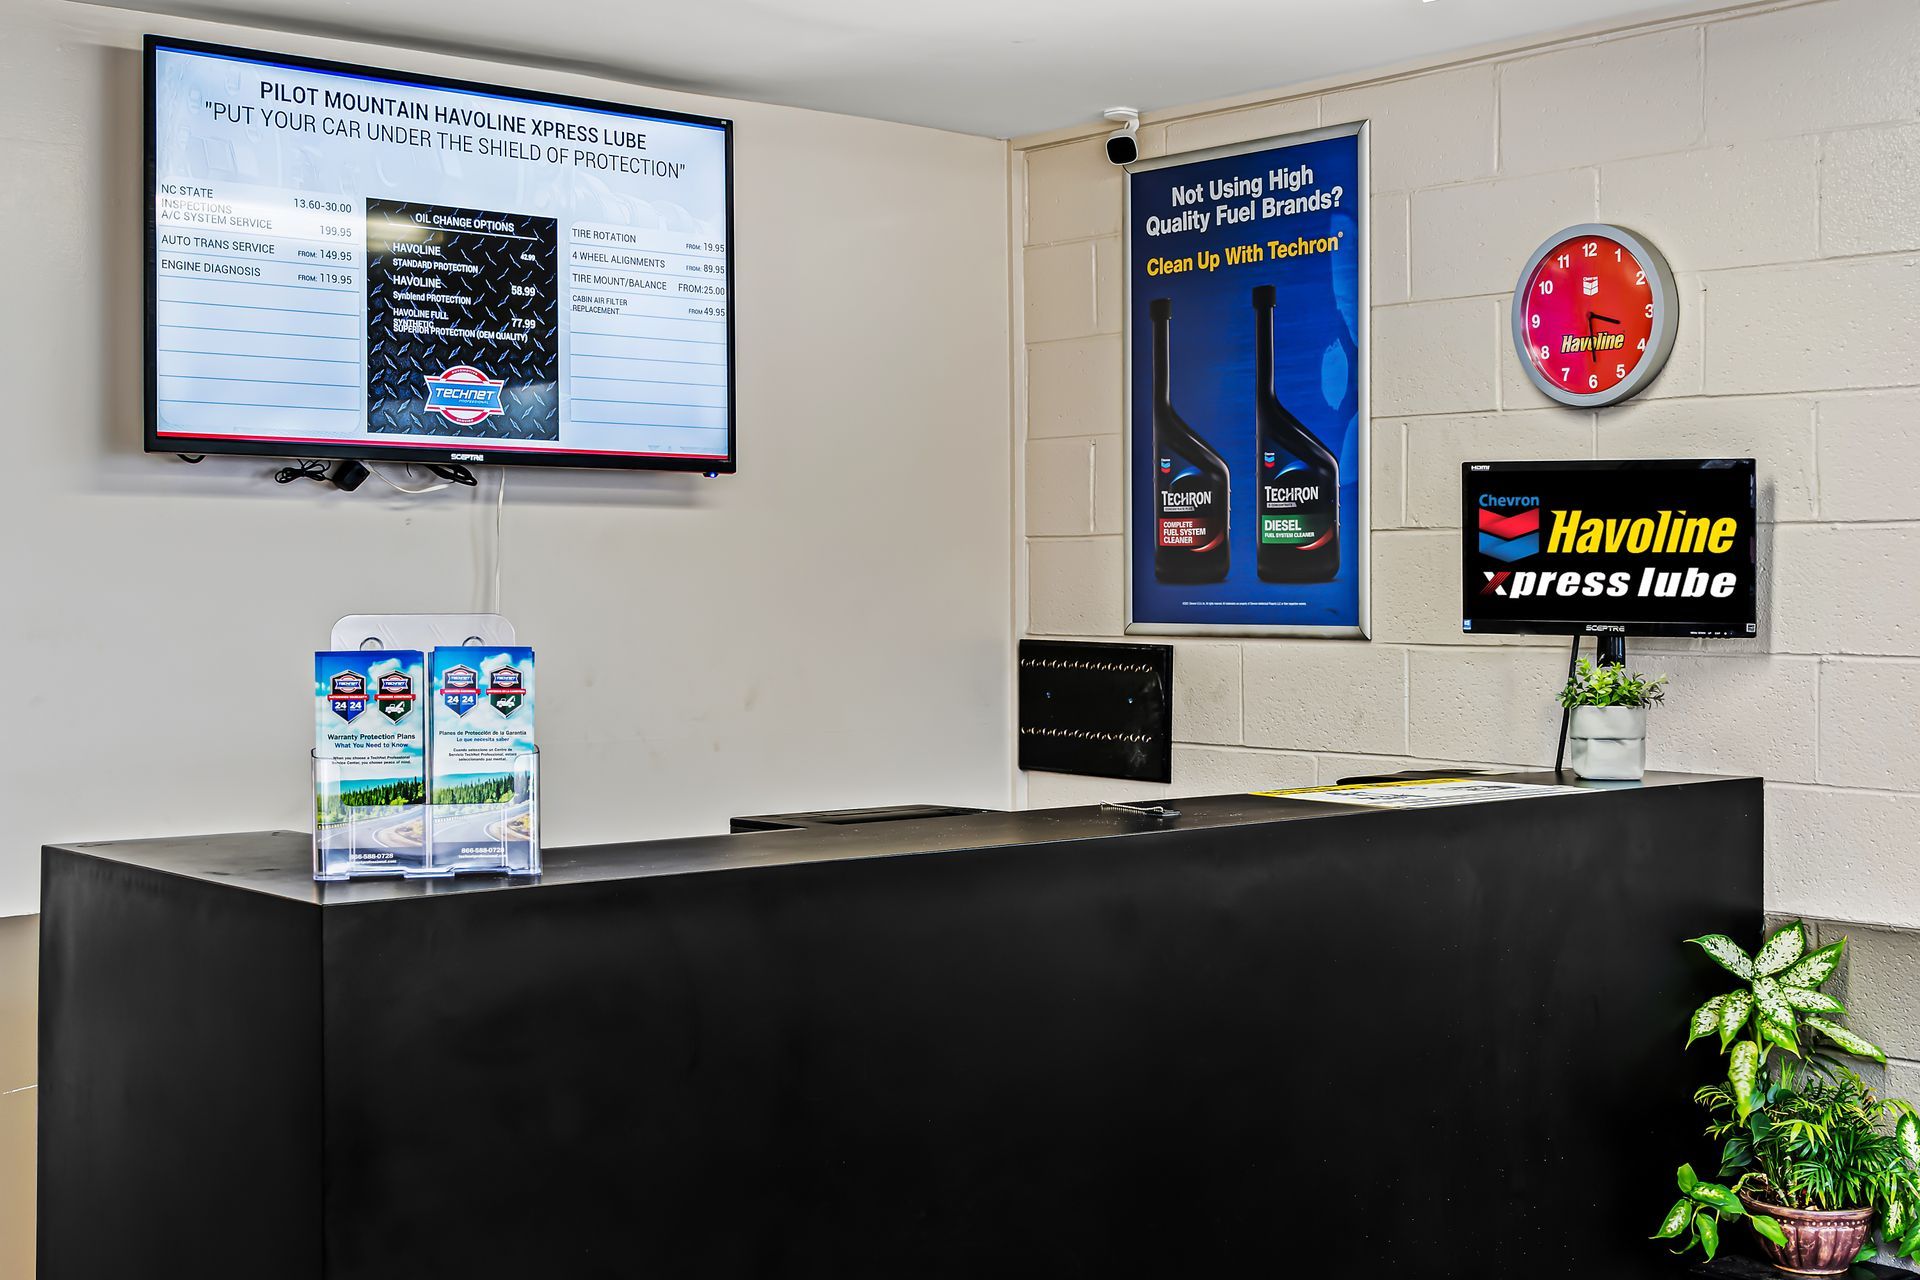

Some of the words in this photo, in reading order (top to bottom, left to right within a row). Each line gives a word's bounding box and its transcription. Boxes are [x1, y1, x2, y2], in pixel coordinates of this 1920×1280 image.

[260, 81, 318, 106] PILOT
[325, 90, 429, 122] MOUNTAIN
[435, 105, 526, 134] HAVOLINE
[531, 119, 599, 143] XPRESS
[604, 129, 647, 150] LUBE
[205, 101, 254, 124] "PUT
[261, 108, 316, 132] YOUR
[322, 117, 361, 138] CAR
[367, 123, 431, 148] UNDER
[437, 132, 473, 152] THE
[478, 138, 541, 161] SHIELD
[547, 147, 569, 164] OF
[574, 150, 685, 178] PROTECTION"
[161, 184, 177, 194] NC
[179, 185, 214, 198] STATE
[1172, 183, 1204, 207] Not
[1209, 176, 1263, 200] Using
[1269, 164, 1313, 191] High
[161, 198, 232, 214] INSPECTIONS
[294, 198, 352, 213] 13.60-30.00
[1146, 211, 1211, 237] Quality
[1216, 201, 1255, 226] Fuel
[1262, 186, 1343, 219] Brands?
[161, 212, 181, 220] A/C
[183, 212, 227, 225] SYSTEM
[229, 217, 272, 229] SERVICE
[415, 213, 431, 224] OIL
[432, 215, 472, 228] CHANGE
[473, 219, 515, 232] OPTIONS
[319, 225, 352, 237] 199.95
[572, 228, 591, 238] TIRE
[593, 231, 636, 243] ROTATION
[161, 234, 191, 246] AUTO
[193, 237, 230, 250] TRANS
[232, 241, 275, 254] SERVICE
[392, 242, 441, 256] HAVOLINE
[704, 242, 725, 252] 19.95
[1582, 242, 1598, 257] 12
[297, 250, 318, 259] FROM:
[319, 249, 352, 261] 149.95
[572, 251, 578, 260] 4
[579, 252, 609, 263] WHEEL
[610, 255, 666, 268] ALIGNMENTS
[1147, 257, 1193, 276] Clean
[1197, 251, 1220, 271] Up
[1225, 243, 1264, 266] With
[1557, 254, 1570, 269] 11
[1615, 248, 1622, 263] 1
[161, 259, 201, 272] ENGINE
[203, 262, 261, 277] DIAGNOSIS
[392, 258, 432, 270] STANDARD
[433, 261, 479, 274] PROTECTION
[703, 264, 725, 274] 89.95
[297, 274, 318, 282] FROM:
[319, 272, 352, 285] 119.95
[392, 275, 441, 289] HAVOLINE
[572, 273, 591, 283] TIRE
[593, 275, 667, 290] MOUNT/BALANCE
[1636, 270, 1646, 286] 2
[511, 285, 536, 297] 58.99
[1539, 280, 1554, 295] 10
[426, 293, 472, 305] PROTECTION
[572, 295, 592, 303] CABIN
[594, 296, 605, 304] AIR
[606, 298, 628, 306] FILTER
[392, 308, 429, 318] HAVOLINE
[430, 311, 449, 320] FULL
[572, 305, 620, 315] REPLACEMENT
[704, 307, 725, 317] 49.95
[1645, 303, 1654, 318] 3
[392, 318, 434, 328] SYNTHETIC
[511, 318, 536, 329] 77.99
[1531, 314, 1541, 329] 9
[392, 326, 430, 335] SUPERIOR
[431, 327, 476, 338] PROTECTION
[476, 329, 495, 340] (OEM
[495, 331, 528, 343] QUALITY)
[1560, 332, 1625, 353] Havoline
[1637, 338, 1646, 352] 4
[1541, 345, 1550, 360] 8
[1561, 367, 1570, 382] 7
[1616, 364, 1626, 379] 5
[1588, 374, 1598, 389] 6
[450, 453, 484, 462] SCEPTRE
[1161, 490, 1212, 508] TECHRON
[1264, 486, 1319, 503] TECHRON
[1479, 494, 1540, 507] Chevron
[1163, 528, 1179, 536] FUEL
[1179, 527, 1206, 536] SYSTEM
[1264, 519, 1302, 531] DIESEL
[1547, 510, 1737, 553] Havoline
[1163, 536, 1193, 544] CLEANER
[1637, 567, 1737, 597] lube
[1585, 624, 1625, 632] SCEPTRE
[334, 701, 347, 709] 24
[349, 701, 362, 709] 24
[447, 695, 459, 703] 24
[462, 695, 474, 703] 24
[328, 733, 358, 741] Warranty
